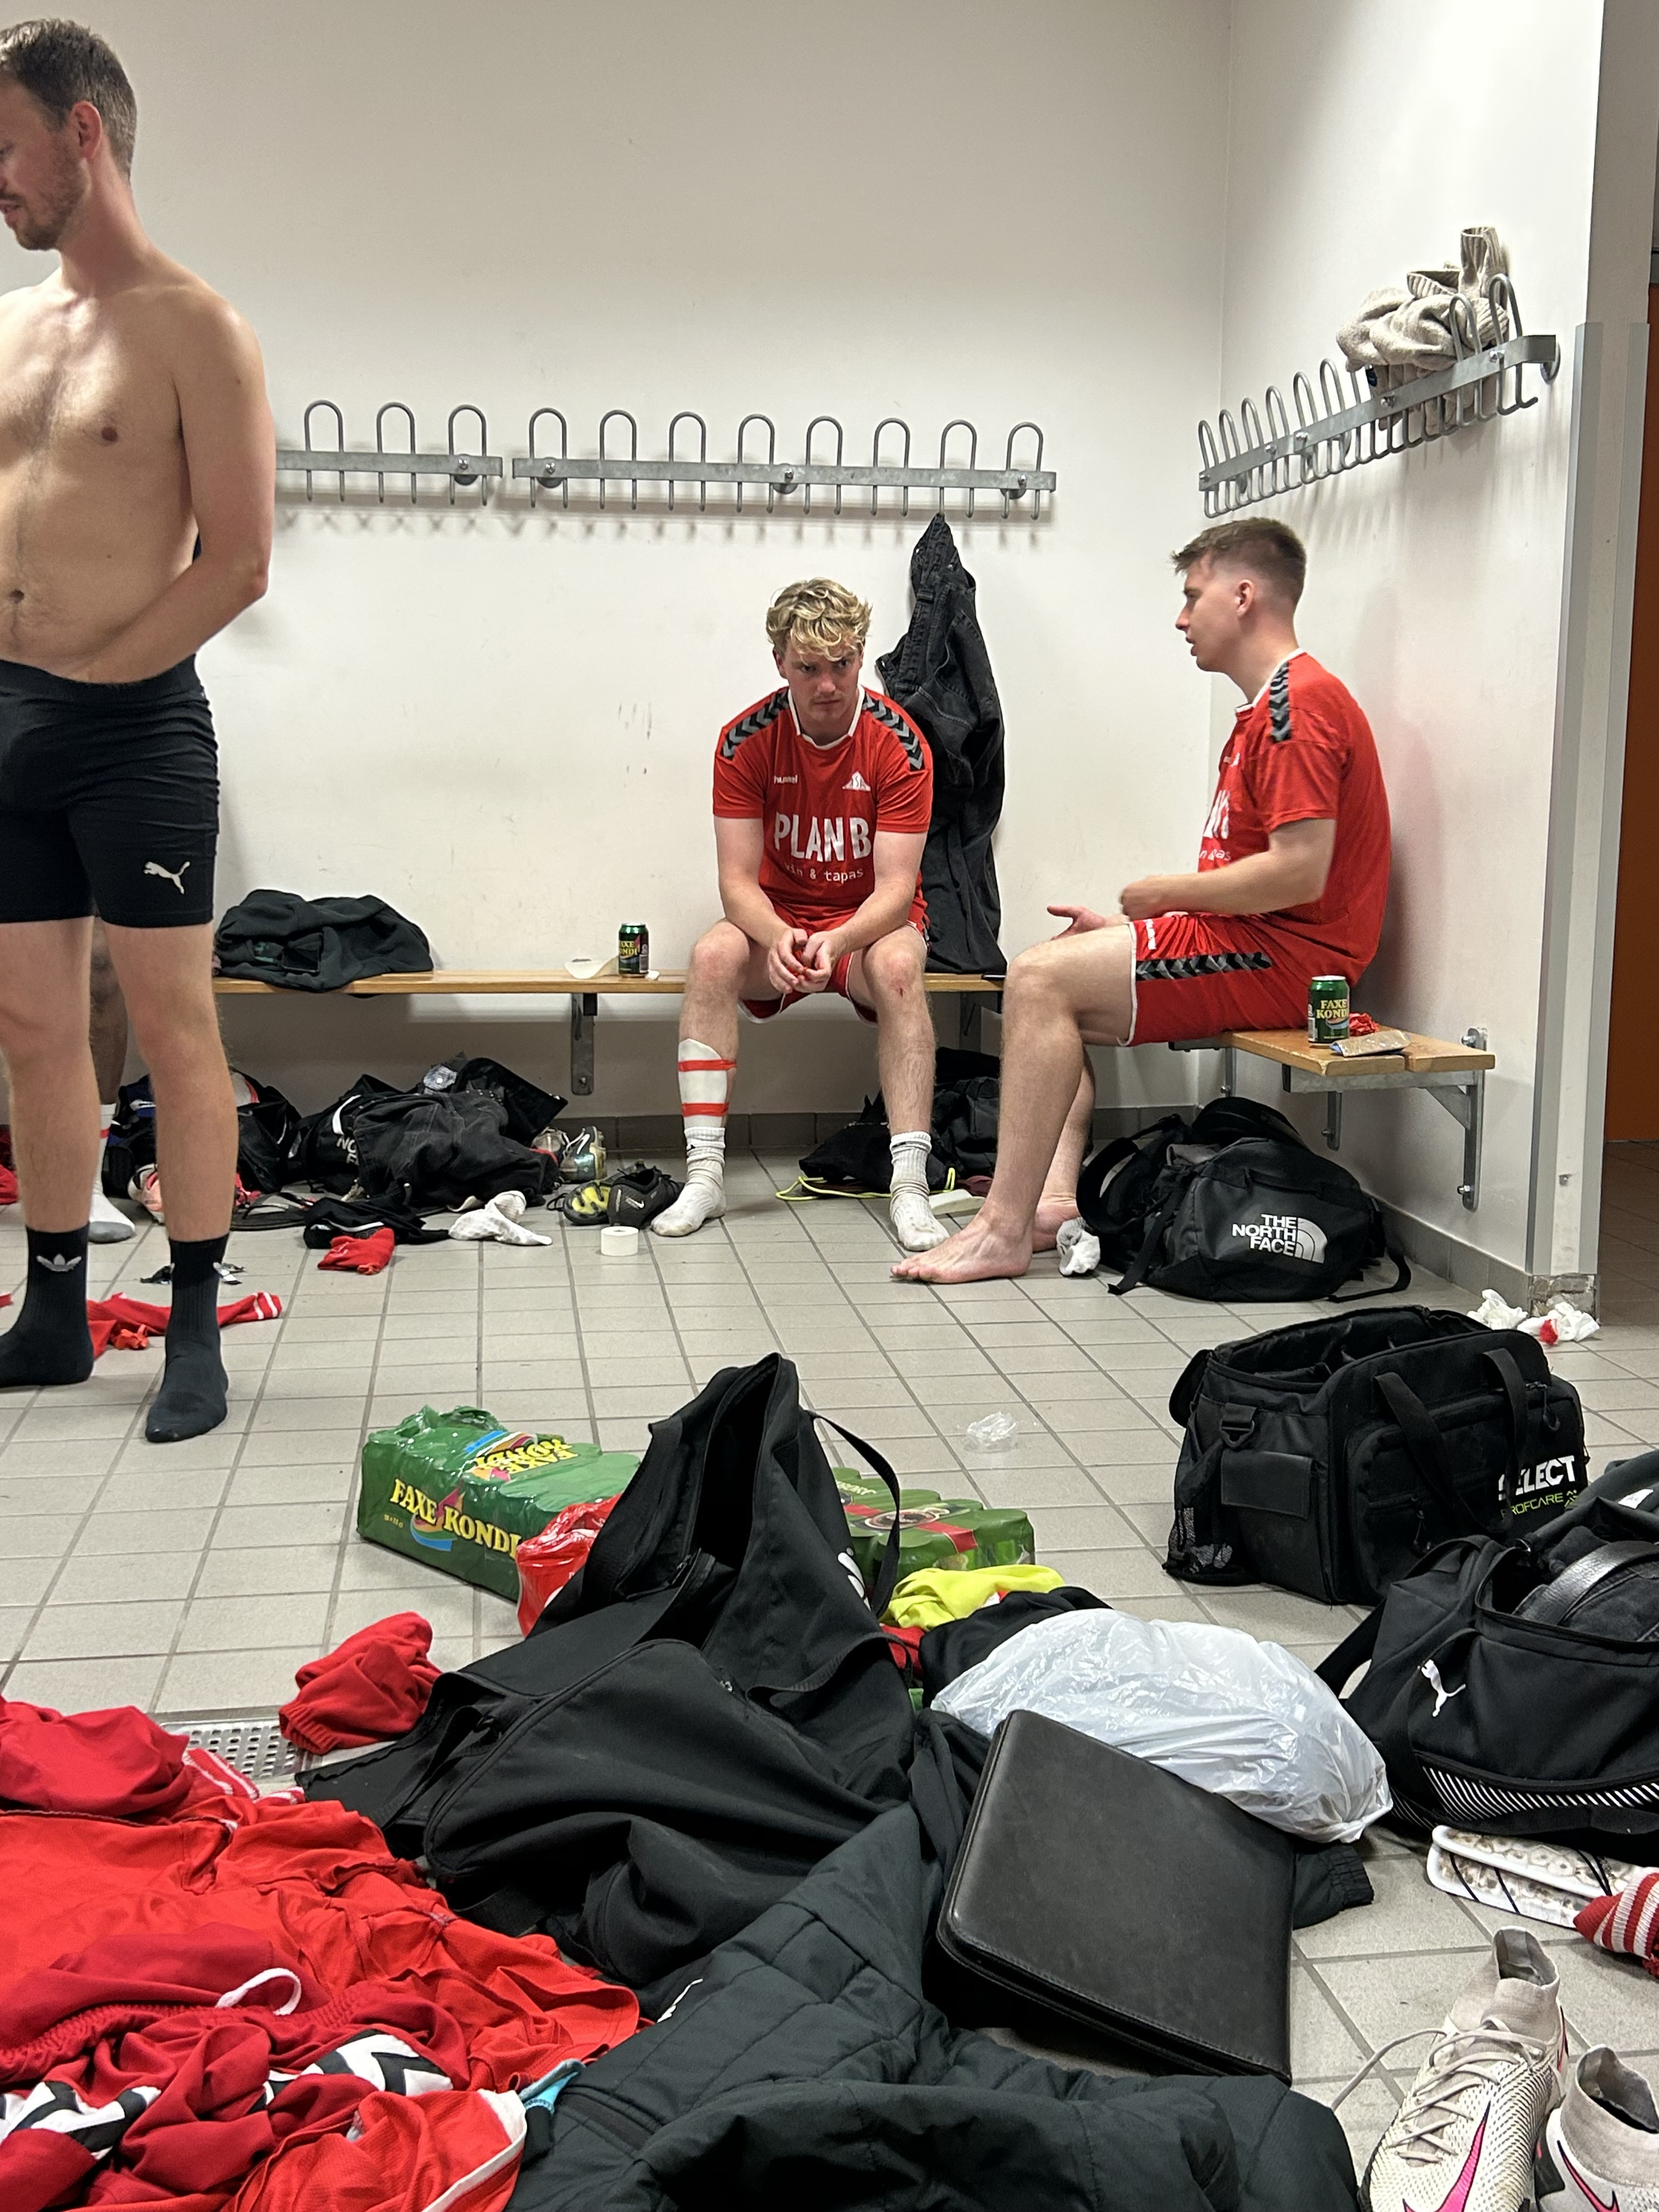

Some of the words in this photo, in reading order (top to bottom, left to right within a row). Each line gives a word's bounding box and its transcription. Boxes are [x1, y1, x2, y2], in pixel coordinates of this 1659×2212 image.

[774, 811, 845, 862] PLAN
[849, 817, 872, 860] B
[785, 862, 804, 877] vin
[810, 868, 817, 880] &
[824, 868, 864, 884] tapas
[1320, 999, 1348, 1009] FAXE
[1261, 1214, 1297, 1229] THE
[1232, 1223, 1296, 1242] NORTH
[1250, 1236, 1295, 1257] FACE
[390, 1479, 437, 1525] FAXE
[443, 1505, 522, 1559] KONDI
